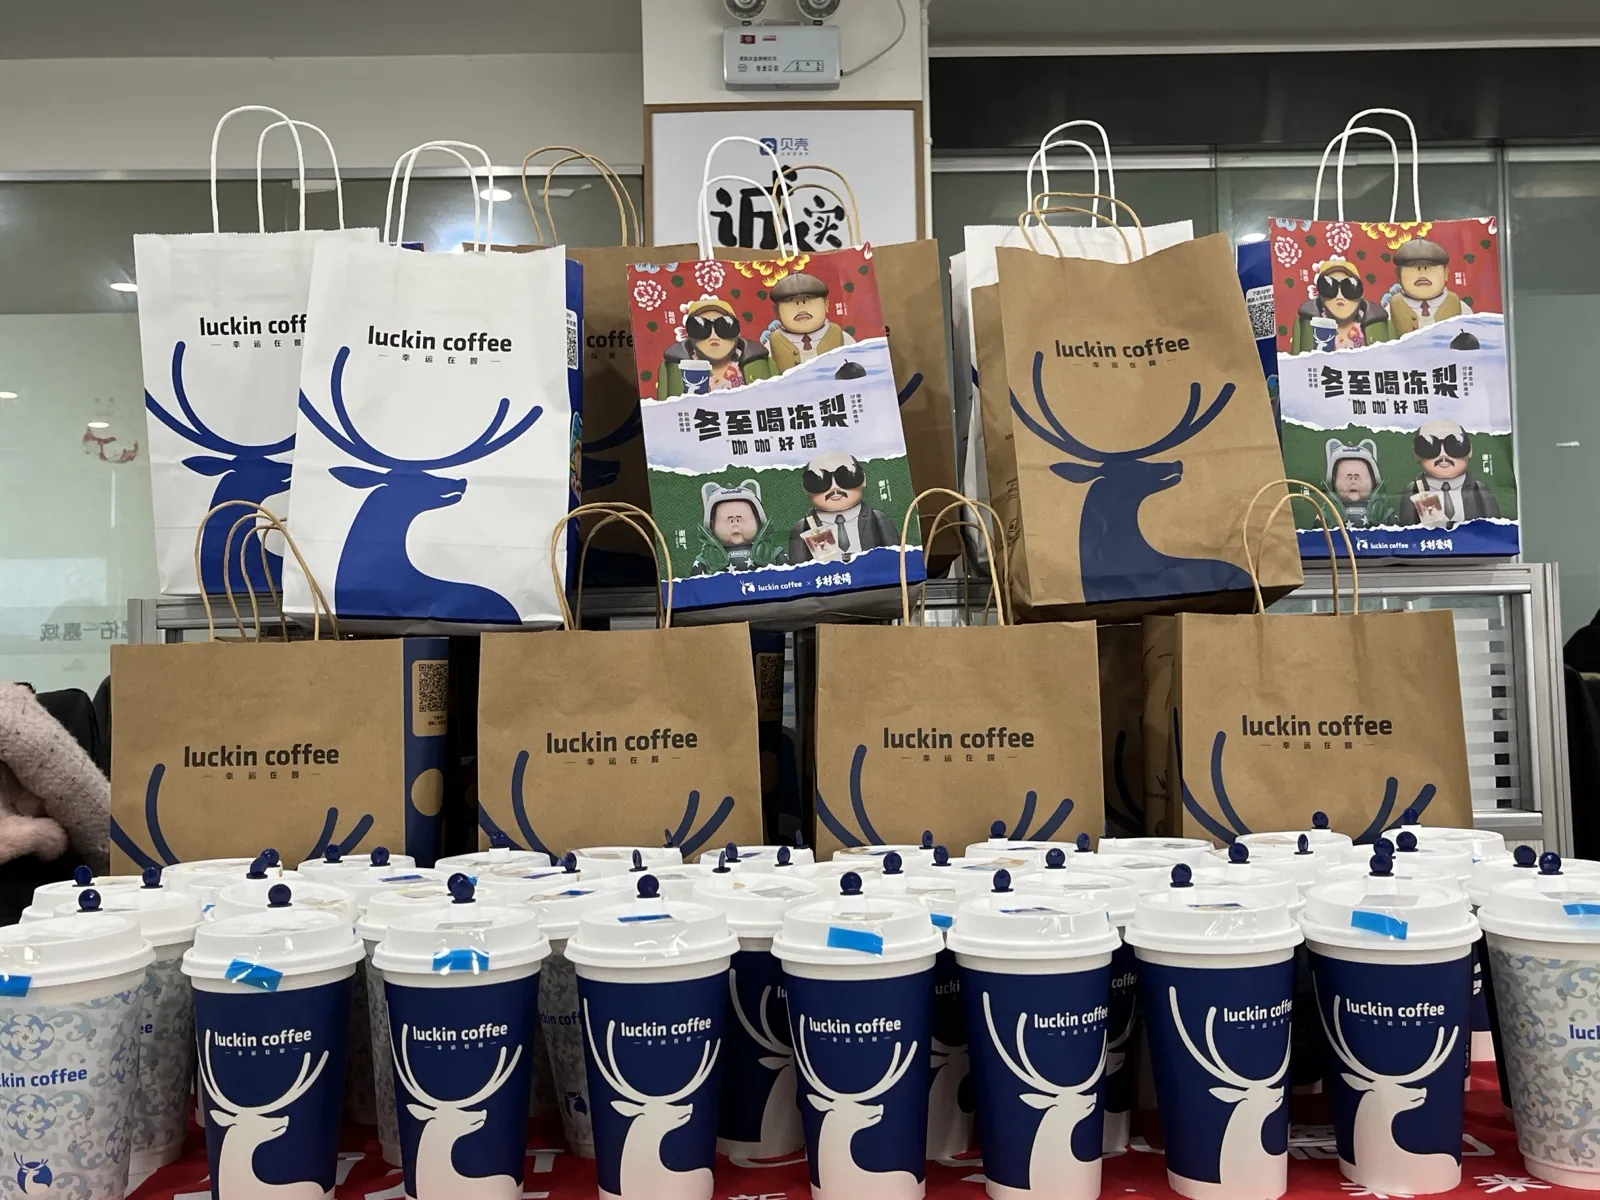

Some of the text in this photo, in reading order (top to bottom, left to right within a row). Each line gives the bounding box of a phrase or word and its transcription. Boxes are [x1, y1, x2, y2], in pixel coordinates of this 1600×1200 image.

[780, 138, 809, 151] 贝壳
[200, 314, 307, 336] luckin coff
[368, 325, 512, 352] luckin coffee
[586, 330, 633, 348] coffe
[1055, 337, 1190, 358] luckin coffee
[1320, 364, 1459, 399] 冬至喝冻梨
[693, 394, 849, 441] 冬至喝冻梨
[757, 581, 803, 591] luckin coffee
[815, 572, 852, 589] 乡村爱情
[1242, 714, 1393, 736] luckin coffee
[546, 728, 698, 754] luckin coffee
[883, 727, 1034, 748] luckin coffee
[184, 743, 339, 768] luckin coffee
[1223, 1005, 1267, 1022] luckin
[1346, 998, 1445, 1018] luckin coffee
[621, 1017, 711, 1037] luckin coffee
[809, 1016, 901, 1034] luckin coffee
[1034, 1011, 1079, 1028] luckin
[214, 1028, 312, 1047] luckin coffee
[413, 1022, 508, 1041] luckin coffee
[0, 1068, 88, 1088] kin coffee
